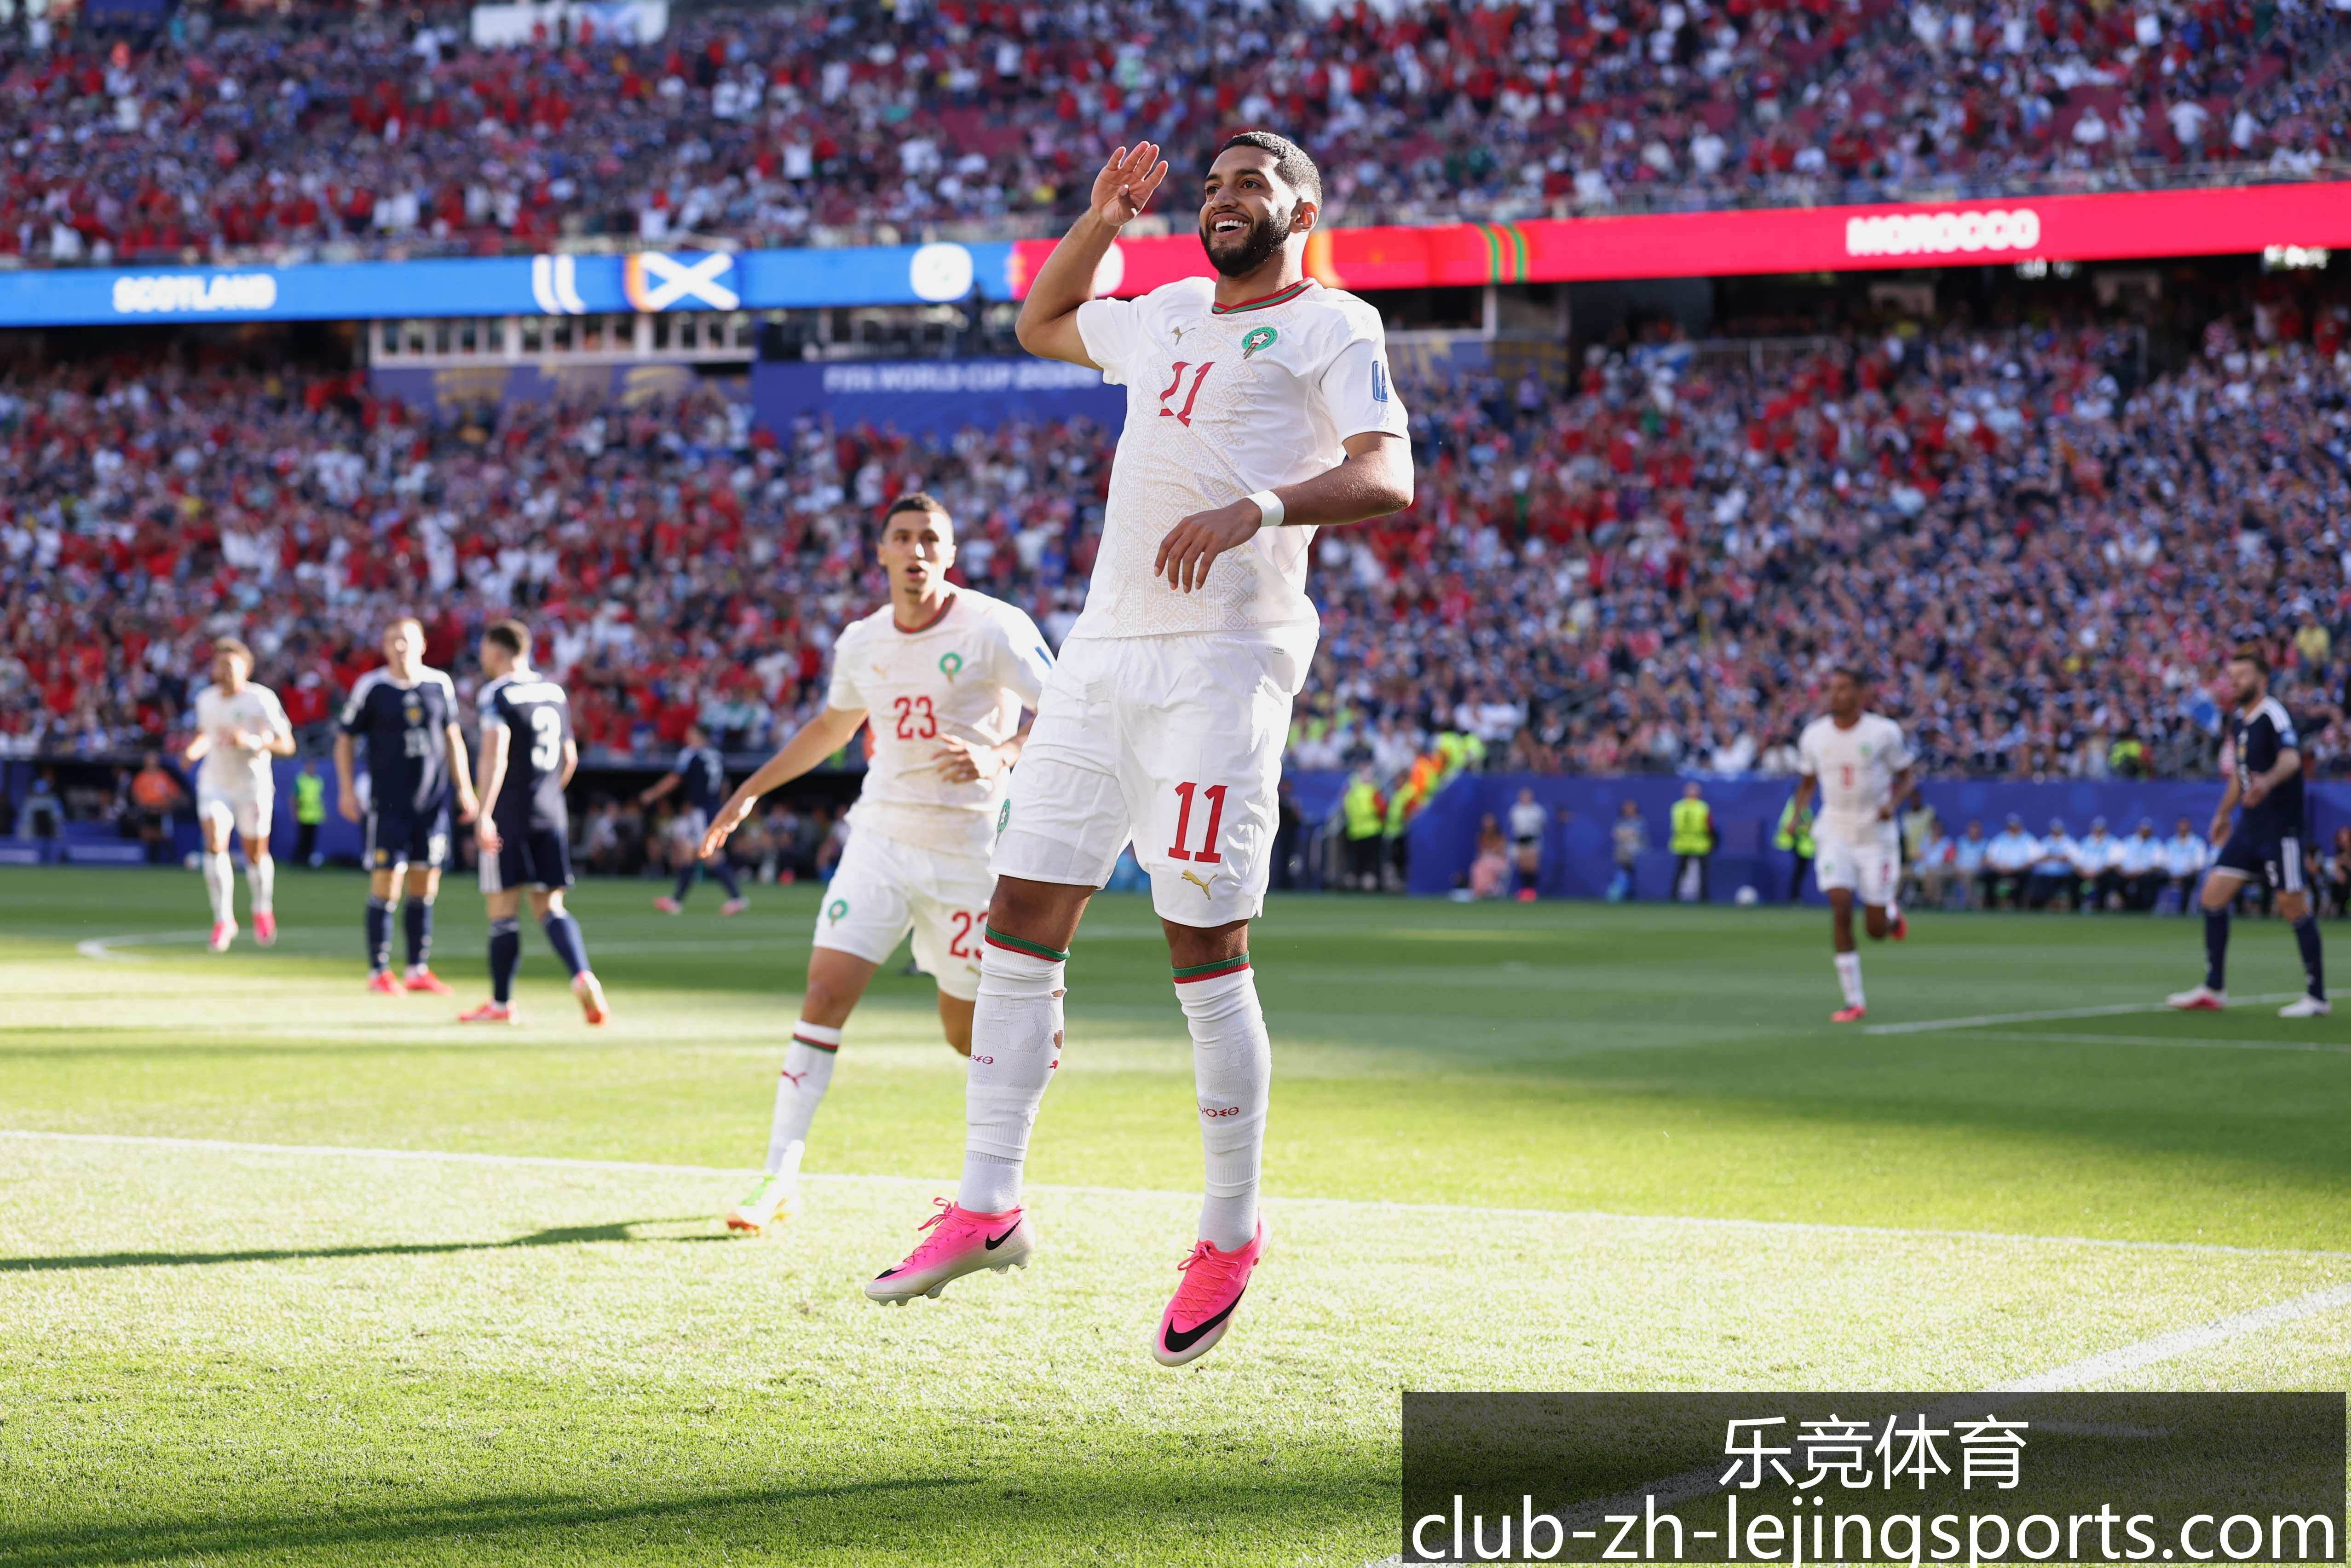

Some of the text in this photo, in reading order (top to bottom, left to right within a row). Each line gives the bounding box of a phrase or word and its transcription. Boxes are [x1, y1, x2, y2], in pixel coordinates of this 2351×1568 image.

[1846, 209, 2040, 255] MOROCCO
[114, 275, 276, 312] SCOTLAND
[879, 363, 962, 392] WORLD
[965, 362, 1011, 391] CUP
[530, 706, 562, 771] 3
[894, 696, 937, 740] 23
[1168, 782, 1227, 863] 11
